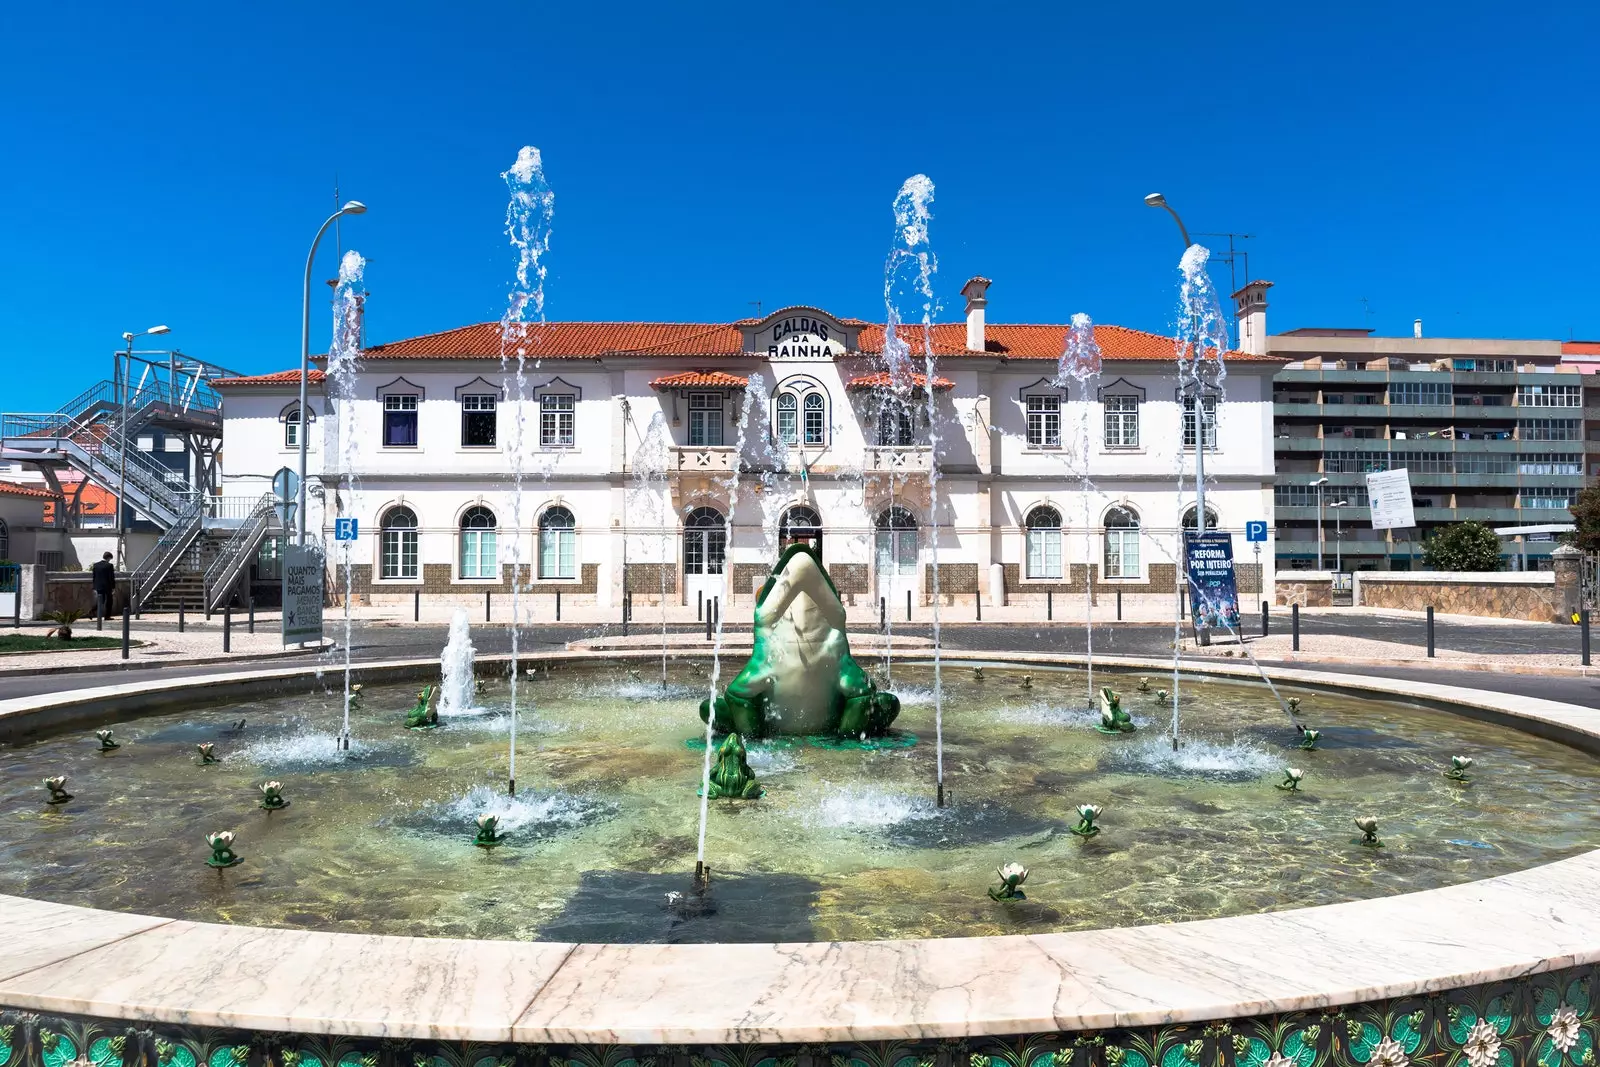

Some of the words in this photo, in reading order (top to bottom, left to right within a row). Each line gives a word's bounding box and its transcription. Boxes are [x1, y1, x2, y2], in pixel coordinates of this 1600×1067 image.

[774, 318, 828, 341] CALDAS
[792, 335, 809, 343] DA
[768, 345, 833, 357] RAINHA
[1251, 523, 1263, 540] P
[1194, 549, 1226, 558] REFORMA
[1190, 560, 1205, 569] POR
[1206, 560, 1232, 569] INTEIRO
[288, 566, 317, 576] QUANTO
[288, 576, 305, 585] MAIS
[287, 585, 321, 596] PAGAMOS
